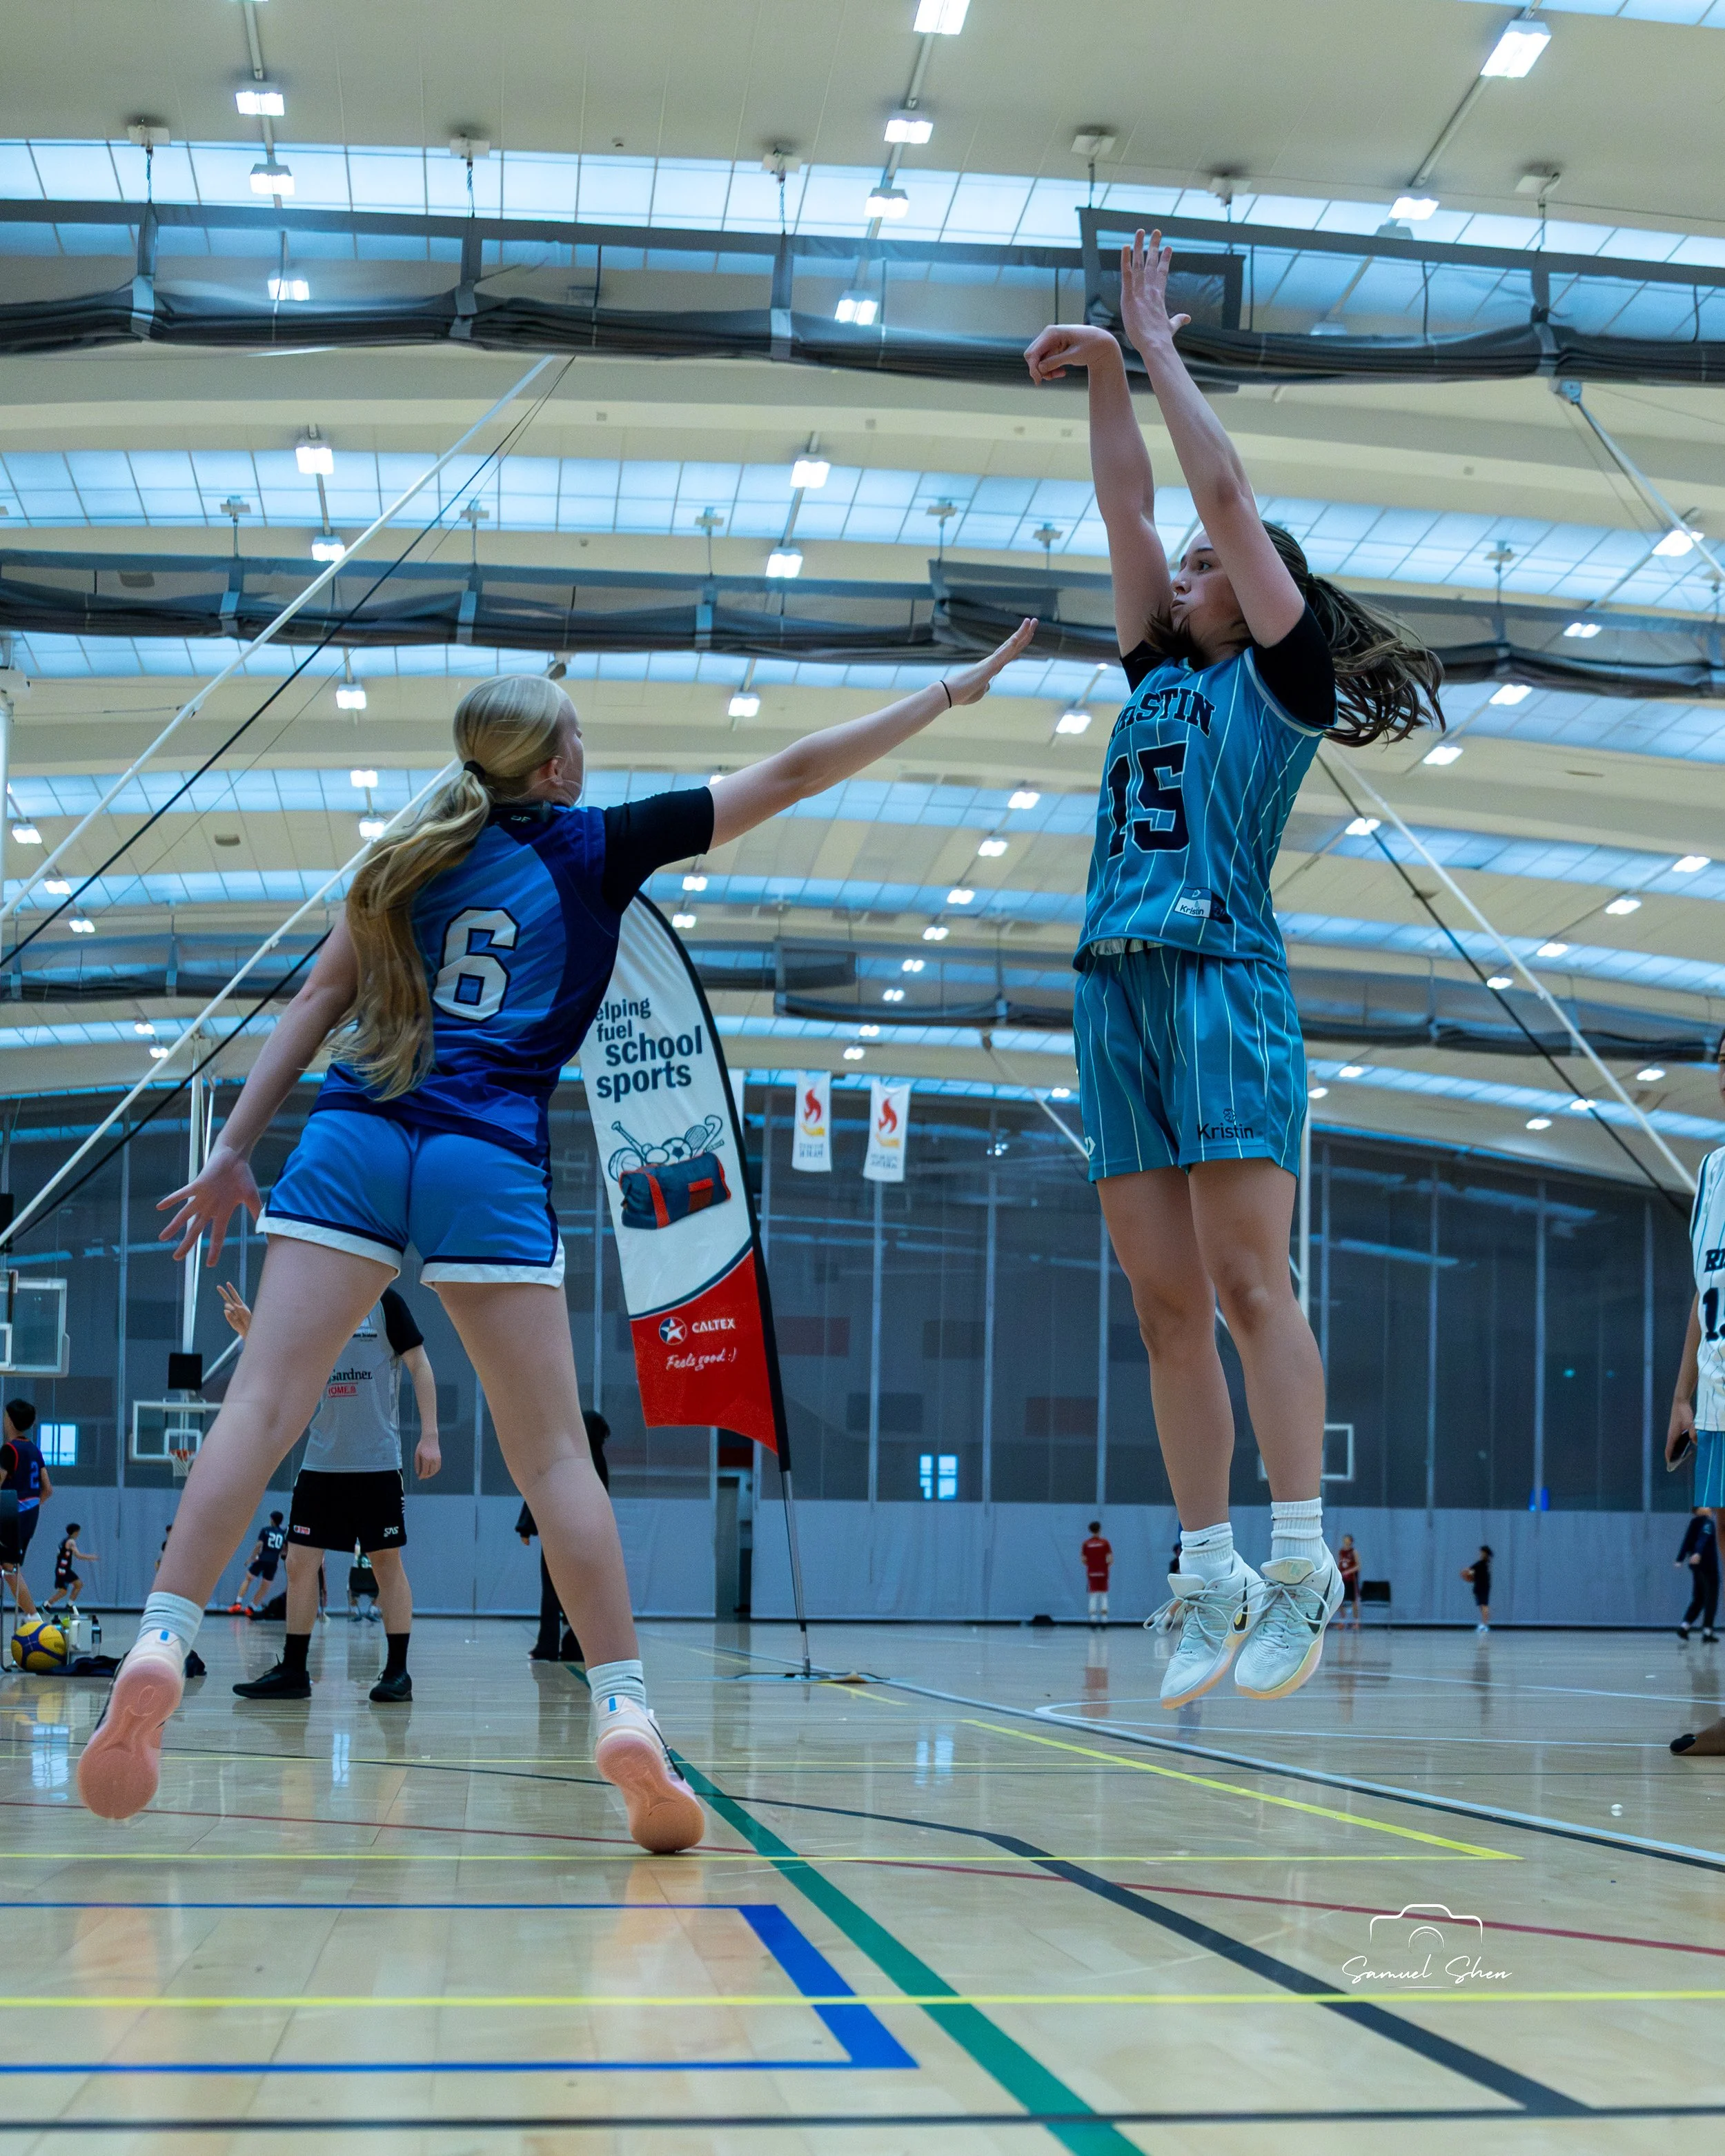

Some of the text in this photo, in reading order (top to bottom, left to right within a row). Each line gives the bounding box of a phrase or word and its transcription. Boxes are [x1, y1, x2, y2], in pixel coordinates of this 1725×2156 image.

[1106, 740, 1190, 862] 15
[1179, 904, 1205, 916] Kristin
[431, 906, 520, 1024] 6
[595, 998, 651, 1024] elping
[596, 1019, 633, 1042] fuel
[605, 1025, 703, 1067] school
[596, 1060, 692, 1103] sports
[1196, 1122, 1254, 1141] Kristin
[691, 1318, 736, 1334] CALTEX
[1702, 1287, 1725, 1342] 1
[694, 1347, 727, 1372] good
[267, 1532, 284, 1550] 20
